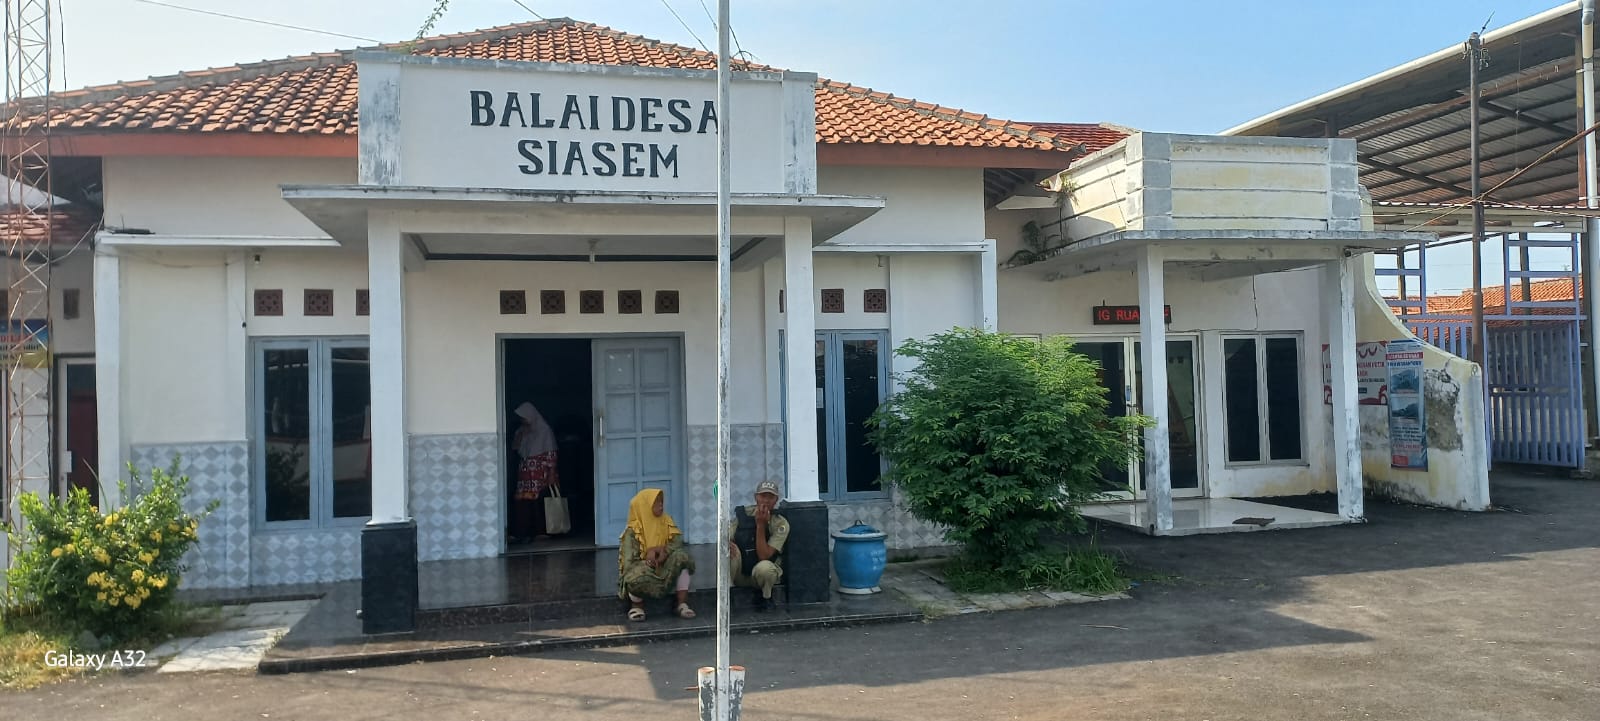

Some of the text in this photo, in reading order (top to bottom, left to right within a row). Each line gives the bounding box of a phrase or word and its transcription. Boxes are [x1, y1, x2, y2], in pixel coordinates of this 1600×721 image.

[470, 90, 718, 134] BALAI DESA
[517, 139, 679, 179] SIASEM
